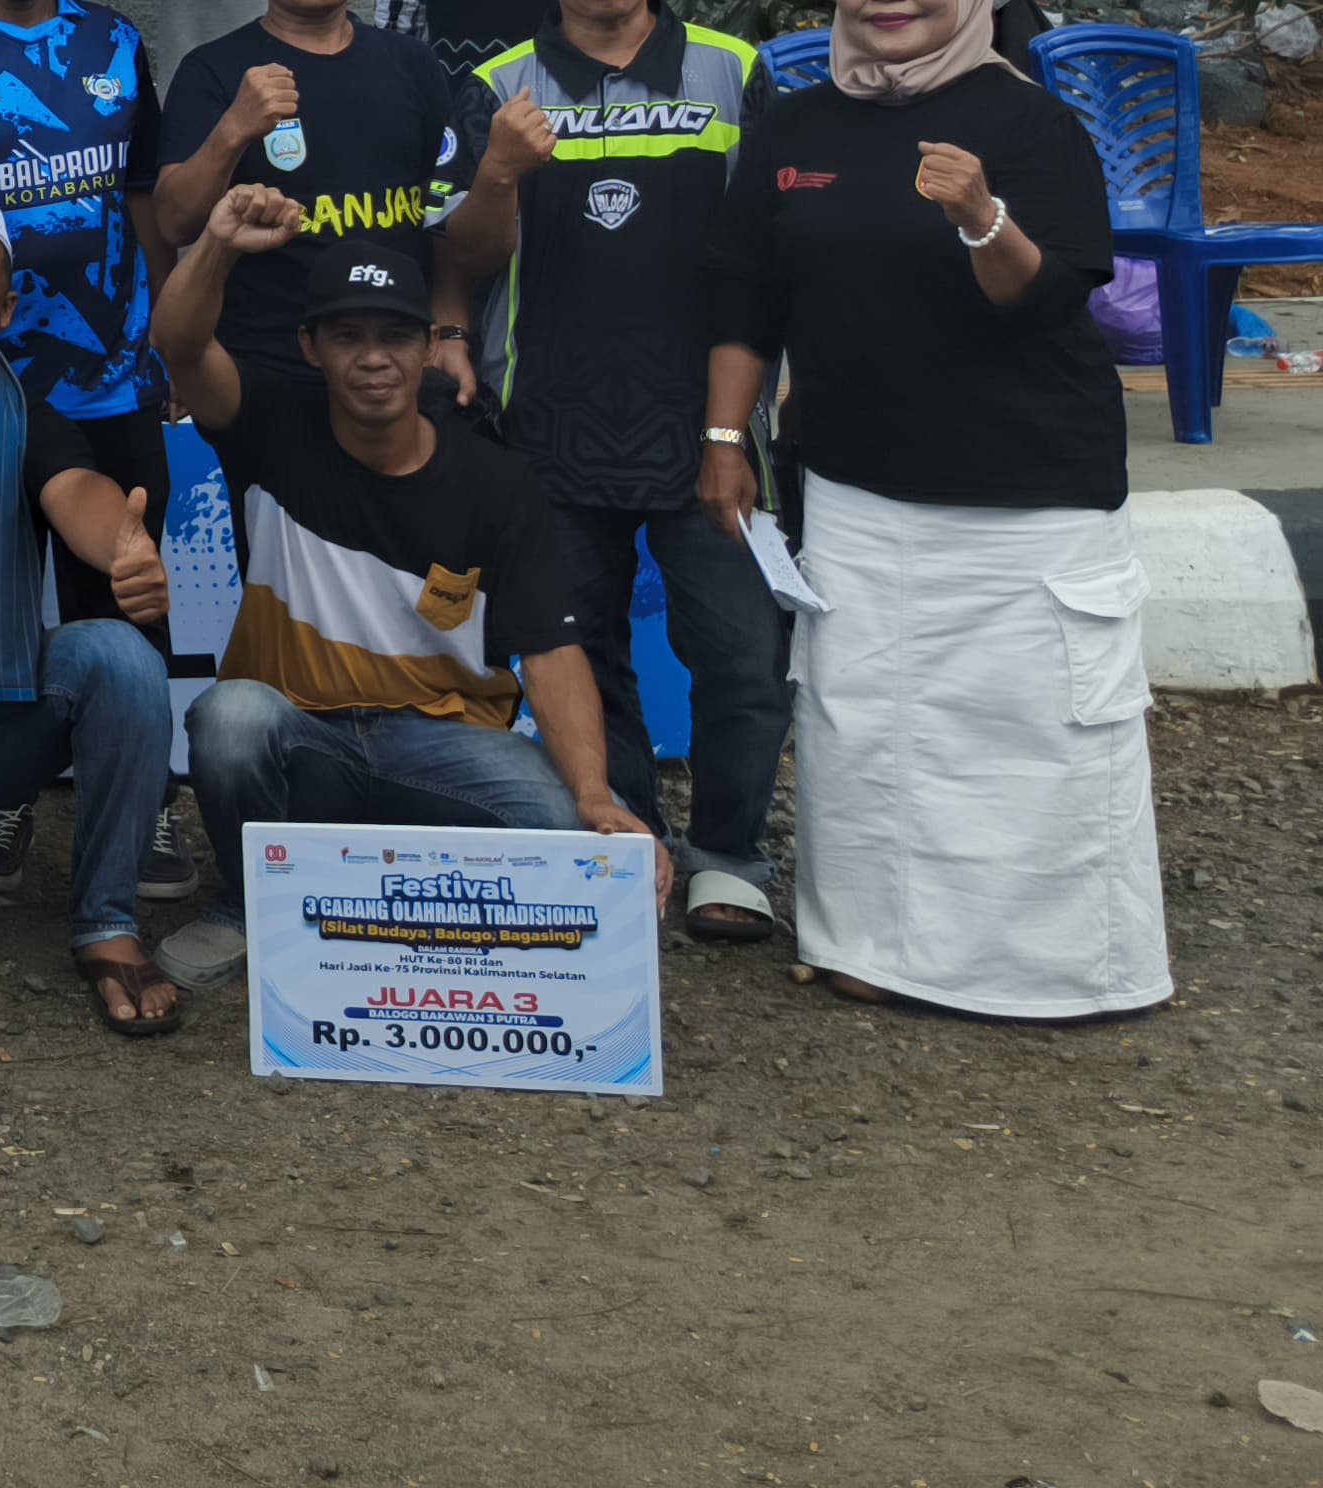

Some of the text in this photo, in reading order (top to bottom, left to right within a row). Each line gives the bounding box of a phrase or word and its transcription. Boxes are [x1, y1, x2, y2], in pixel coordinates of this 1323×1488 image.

[49, 143, 113, 183] PROV
[5, 173, 116, 206] KOTABARU
[348, 264, 395, 288] Efg.
[382, 871, 515, 902] Festival
[304, 897, 597, 926] 3 CABANG OLAHRAGA TRADISIONAL
[321, 921, 364, 936] (Silat
[499, 929, 581, 944] Bagasing)
[319, 961, 586, 981] Hari Jadi Ke-75 Provinsi Kalimantan Selatan
[399, 954, 503, 967] HUT Ke-80 RI dan
[367, 987, 539, 1013] JUARA 3
[368, 1010, 537, 1026] BALOGO BAKAWAN 3 PUTRA
[312, 1021, 598, 1062] Rp. 3.000.000,-
